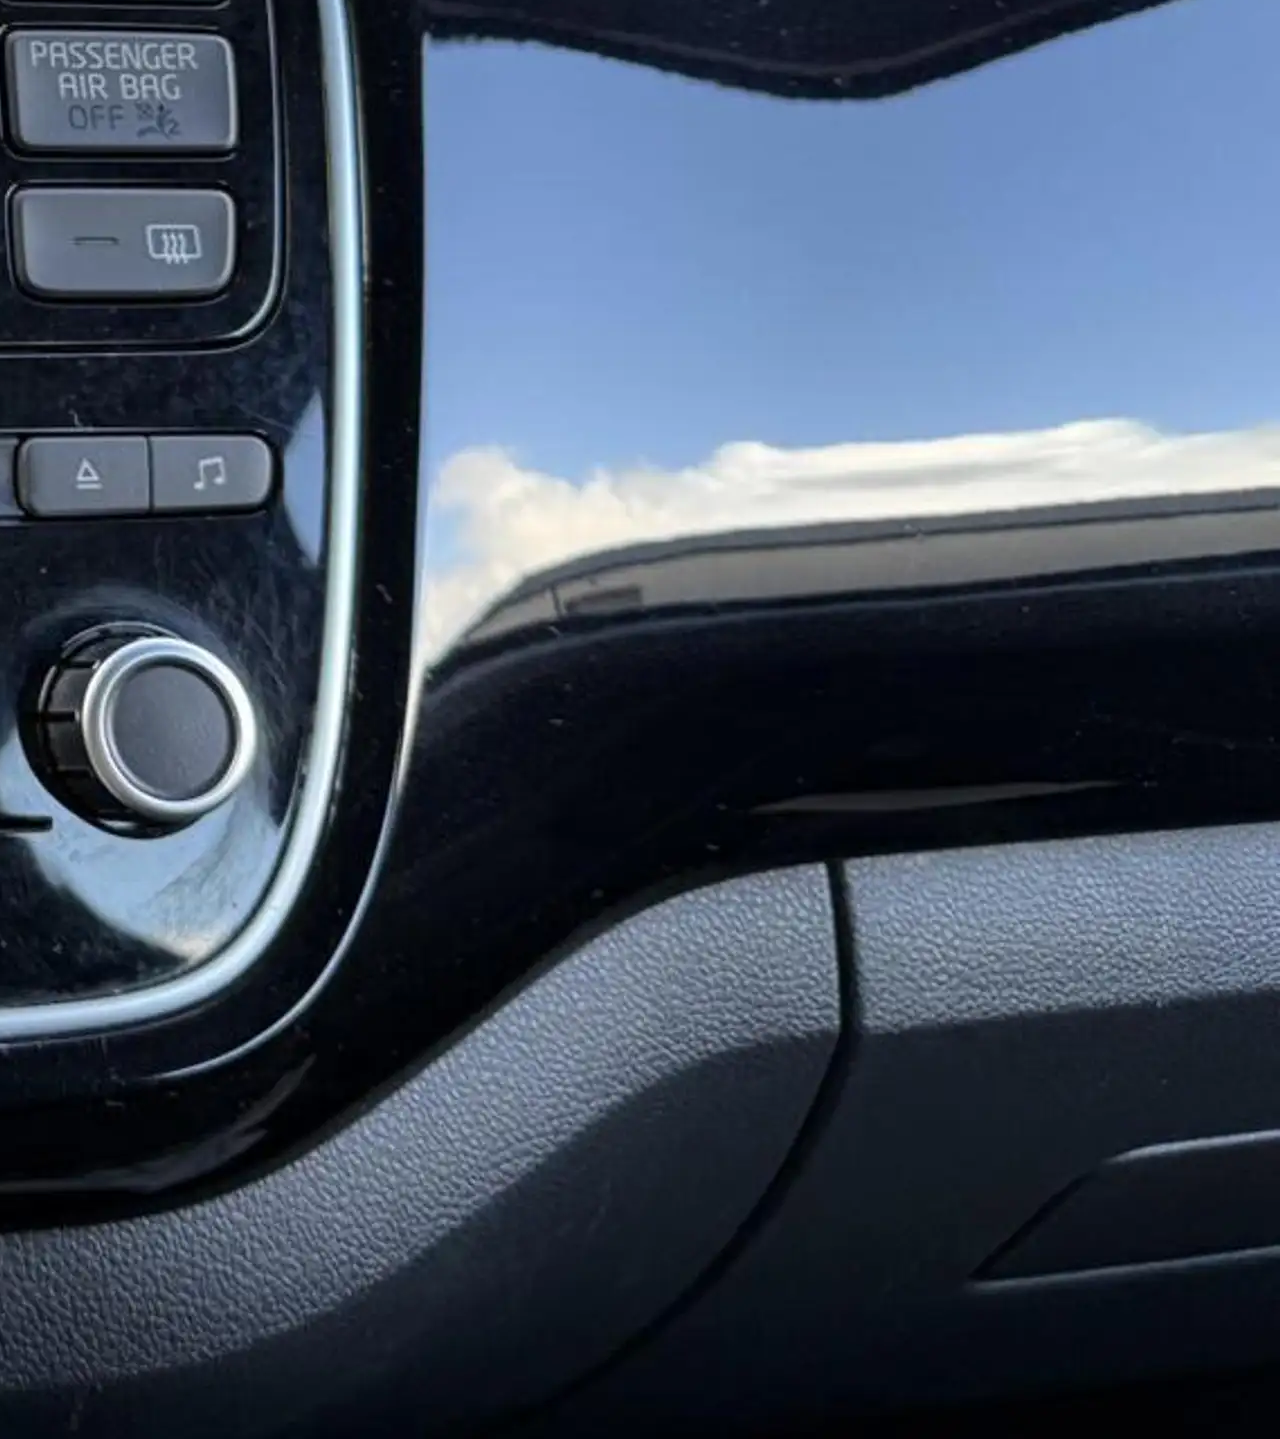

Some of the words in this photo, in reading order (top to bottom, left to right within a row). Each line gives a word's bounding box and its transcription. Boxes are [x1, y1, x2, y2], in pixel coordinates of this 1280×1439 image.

[30, 41, 200, 71] PASSENGER
[58, 71, 110, 101] AIR
[119, 72, 183, 101] BAG
[67, 103, 126, 131] OFF
